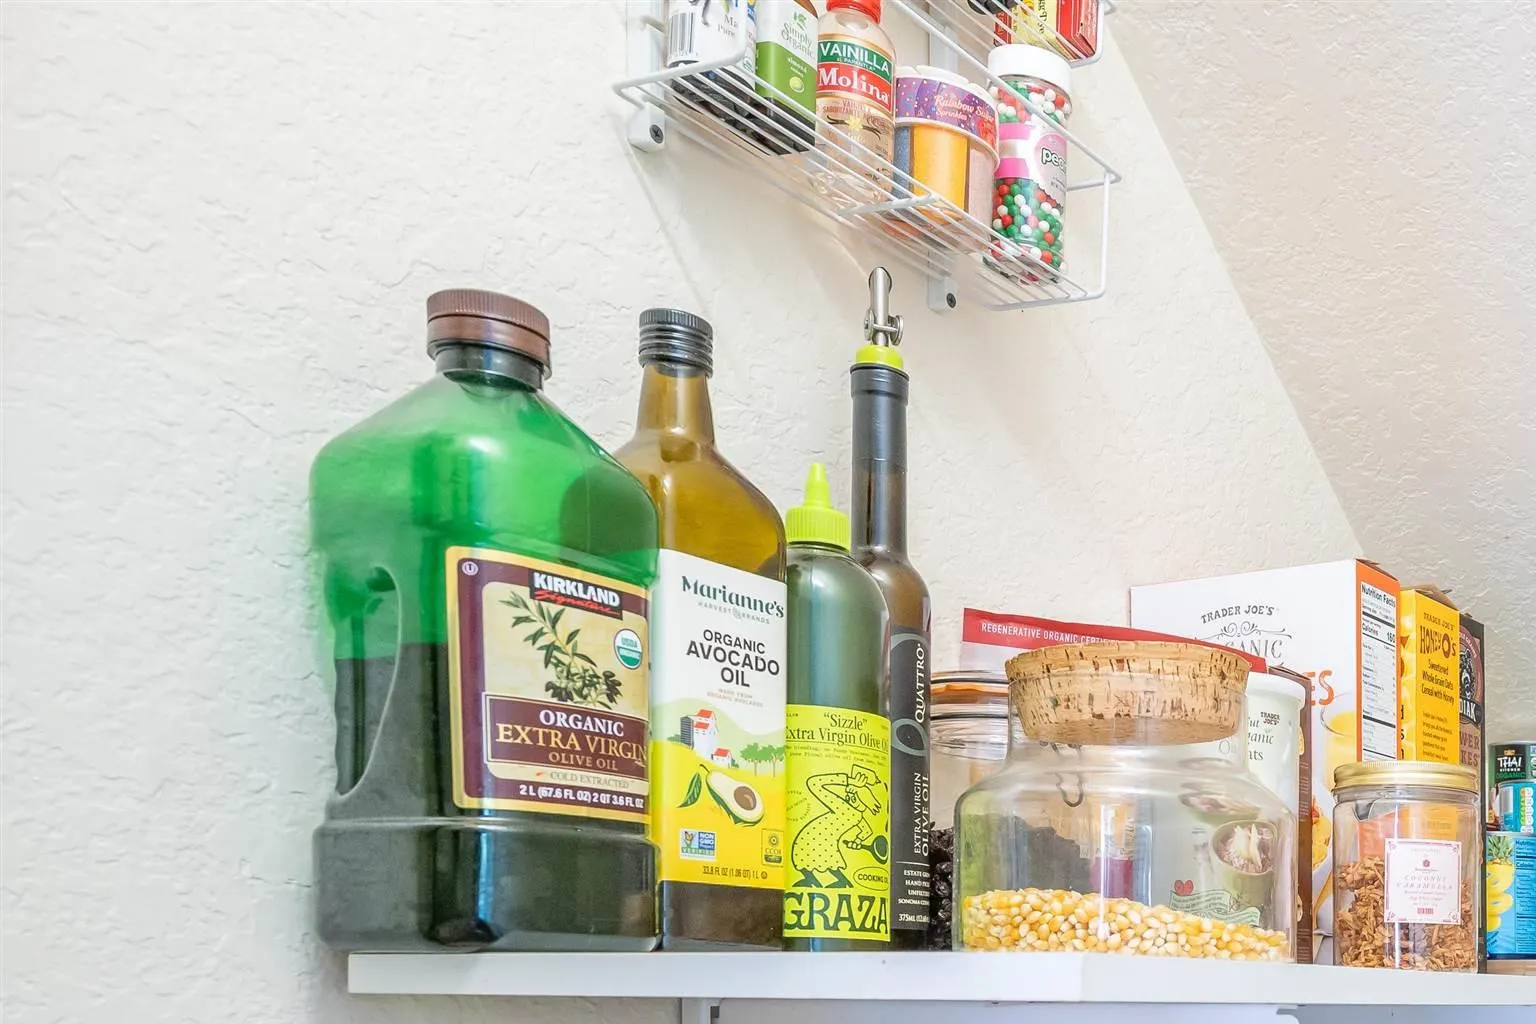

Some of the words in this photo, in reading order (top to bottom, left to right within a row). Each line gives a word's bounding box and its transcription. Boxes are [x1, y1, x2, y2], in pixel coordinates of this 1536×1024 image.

[820, 42, 890, 75] VAINILLA
[819, 67, 889, 105] Molina
[533, 572, 620, 607] KIRKLAND
[682, 576, 784, 618] Marianne's
[1362, 584, 1382, 601] Nutrition
[1201, 605, 1241, 624] TRADER
[1244, 605, 1275, 616] JOE'S
[1424, 613, 1441, 624] TRADER
[981, 622, 1041, 639] REGENERATIVE
[1044, 630, 1078, 644] ORGANIC
[1362, 623, 1378, 636] Calories
[1420, 625, 1442, 655] HONEY
[703, 629, 765, 654] ORGANIC
[686, 640, 780, 676] AVOCADO
[1428, 659, 1448, 675] Sweetened
[721, 667, 750, 688] OIL
[915, 647, 925, 723] QUATTRO
[1422, 671, 1434, 683] Whole
[1421, 683, 1434, 697] Cereal
[1443, 692, 1454, 705] Honey
[539, 710, 625, 737] ORGANIC
[1260, 712, 1280, 720] TRADER
[496, 723, 580, 750] EXTRA
[586, 736, 647, 768] VIRGIN
[819, 728, 856, 746] Virgin
[860, 733, 880, 750] Olive
[549, 752, 592, 767] OLIVE
[598, 758, 618, 771] OIL
[1497, 757, 1522, 768] THAI
[550, 771, 578, 783] COLD
[580, 774, 629, 789] EXTRACTED
[857, 873, 881, 881] COOKING
[784, 892, 888, 933] GRAZA
